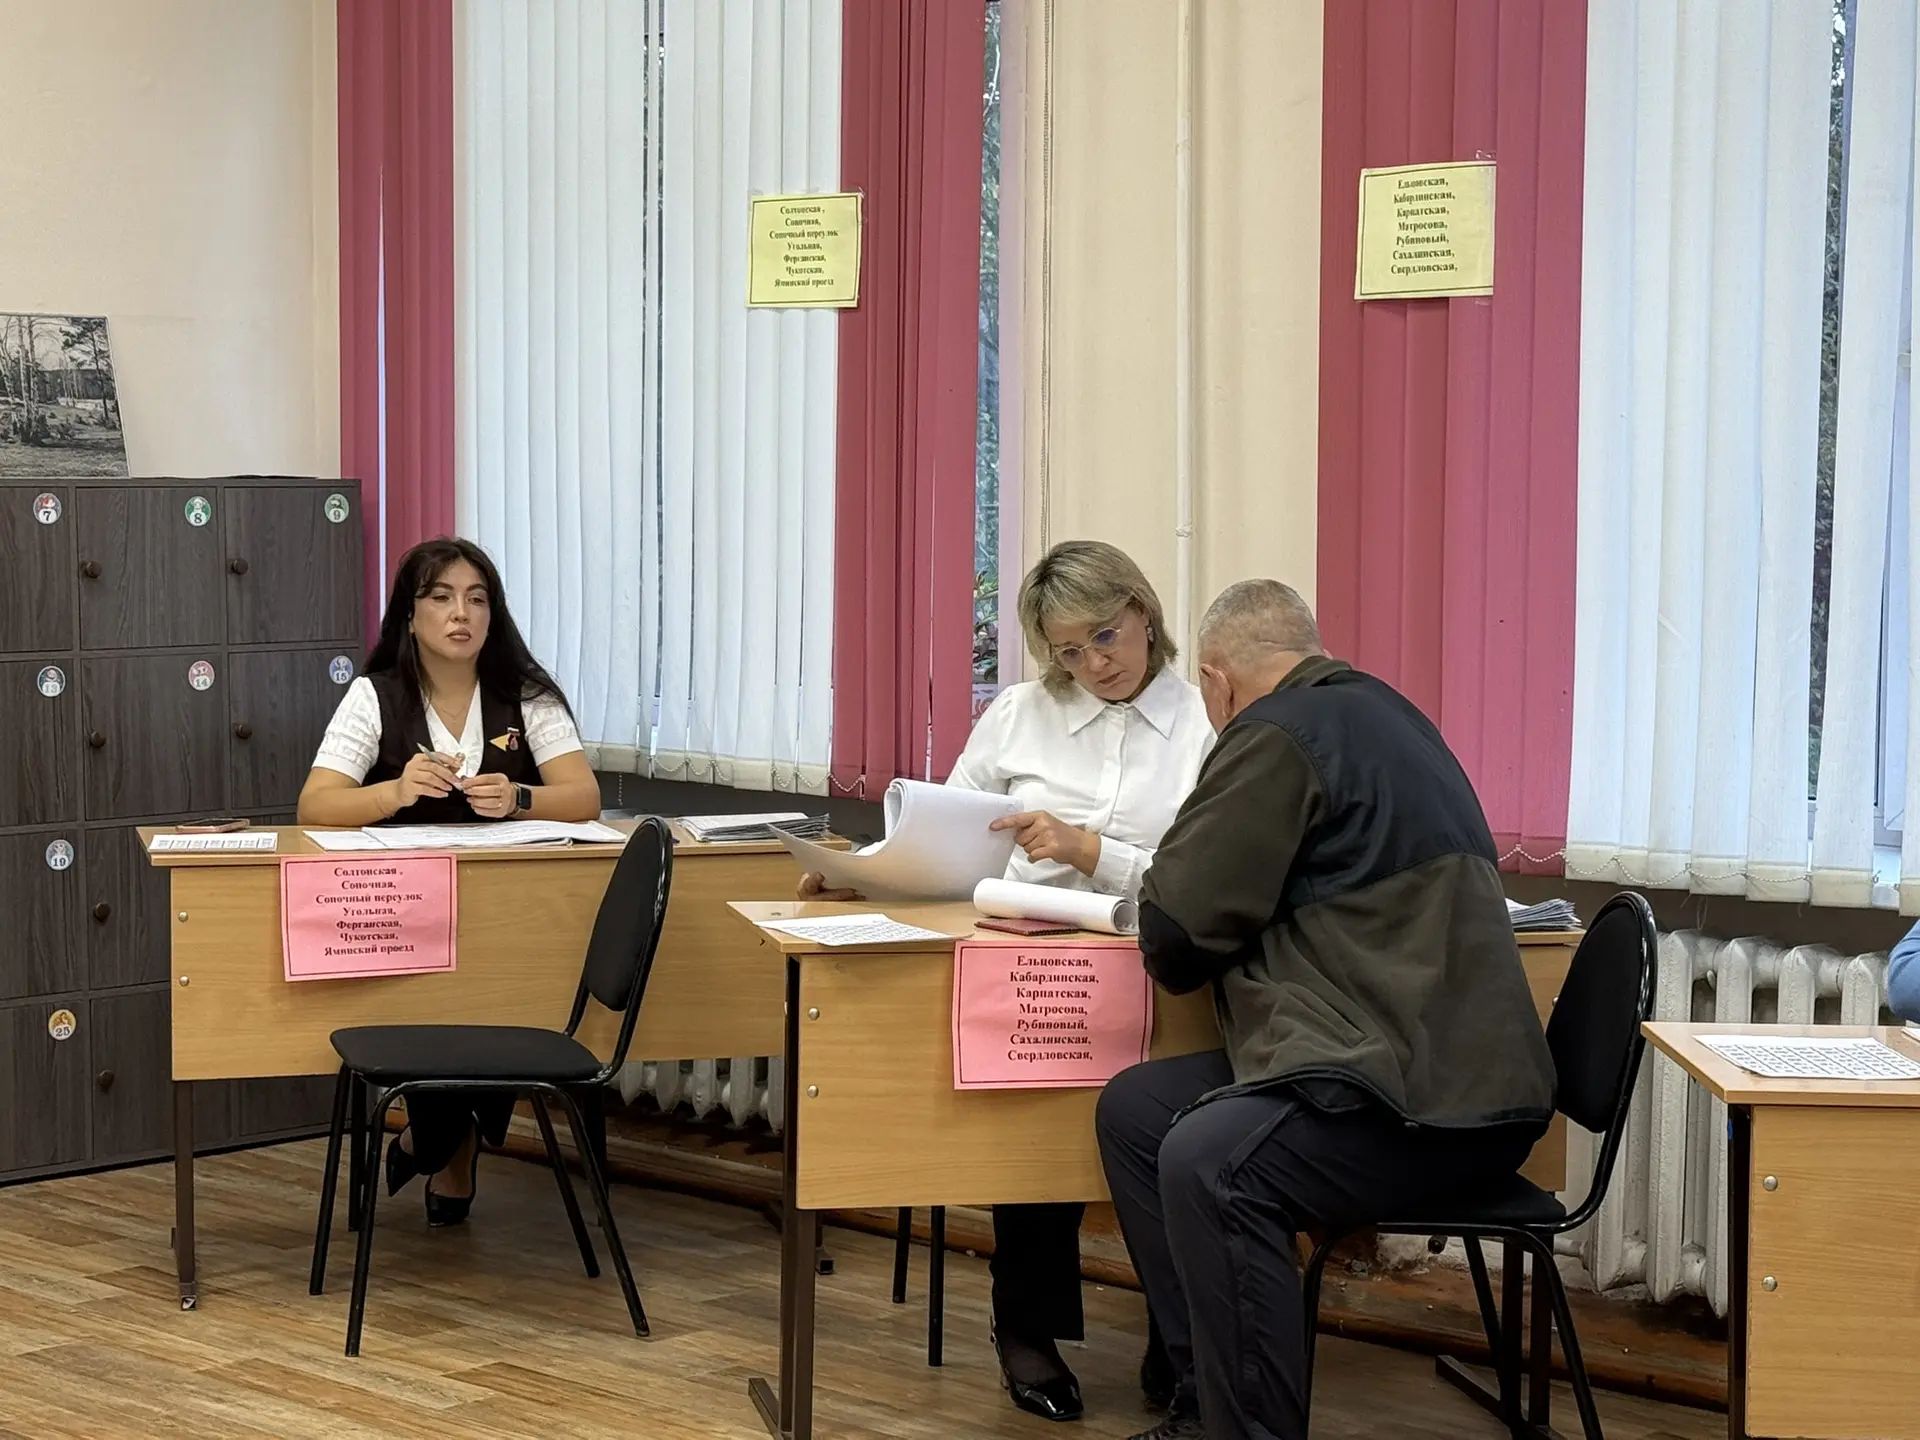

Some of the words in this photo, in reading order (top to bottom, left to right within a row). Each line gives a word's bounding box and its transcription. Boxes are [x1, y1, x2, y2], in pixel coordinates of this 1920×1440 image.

[44, 512, 52, 522] 7
[194, 512, 202, 524] 8
[333, 510, 341, 520] 9
[335, 671, 348, 682] 15
[44, 682, 58, 694] 13
[196, 678, 208, 688] 14
[53, 857, 66, 867] 19
[341, 880, 396, 889] Сопочная,
[316, 894, 371, 904] Сопочный
[374, 893, 422, 903] переулок
[343, 907, 396, 916] Угольная,
[337, 920, 402, 930] Ферганская,
[340, 932, 398, 943] Чукотская,
[381, 944, 414, 954] проезд
[1017, 956, 1092, 967] Ельцовская,
[1010, 972, 1099, 984] Кабардинская,
[1017, 988, 1091, 999] Карпатская,
[1019, 1004, 1087, 1016] Матросова,
[1017, 1019, 1087, 1031] Рубиновый,
[55, 1027, 70, 1037] 25
[1010, 1034, 1091, 1045] Сахалинская,
[1008, 1050, 1092, 1062] Свердловская,
